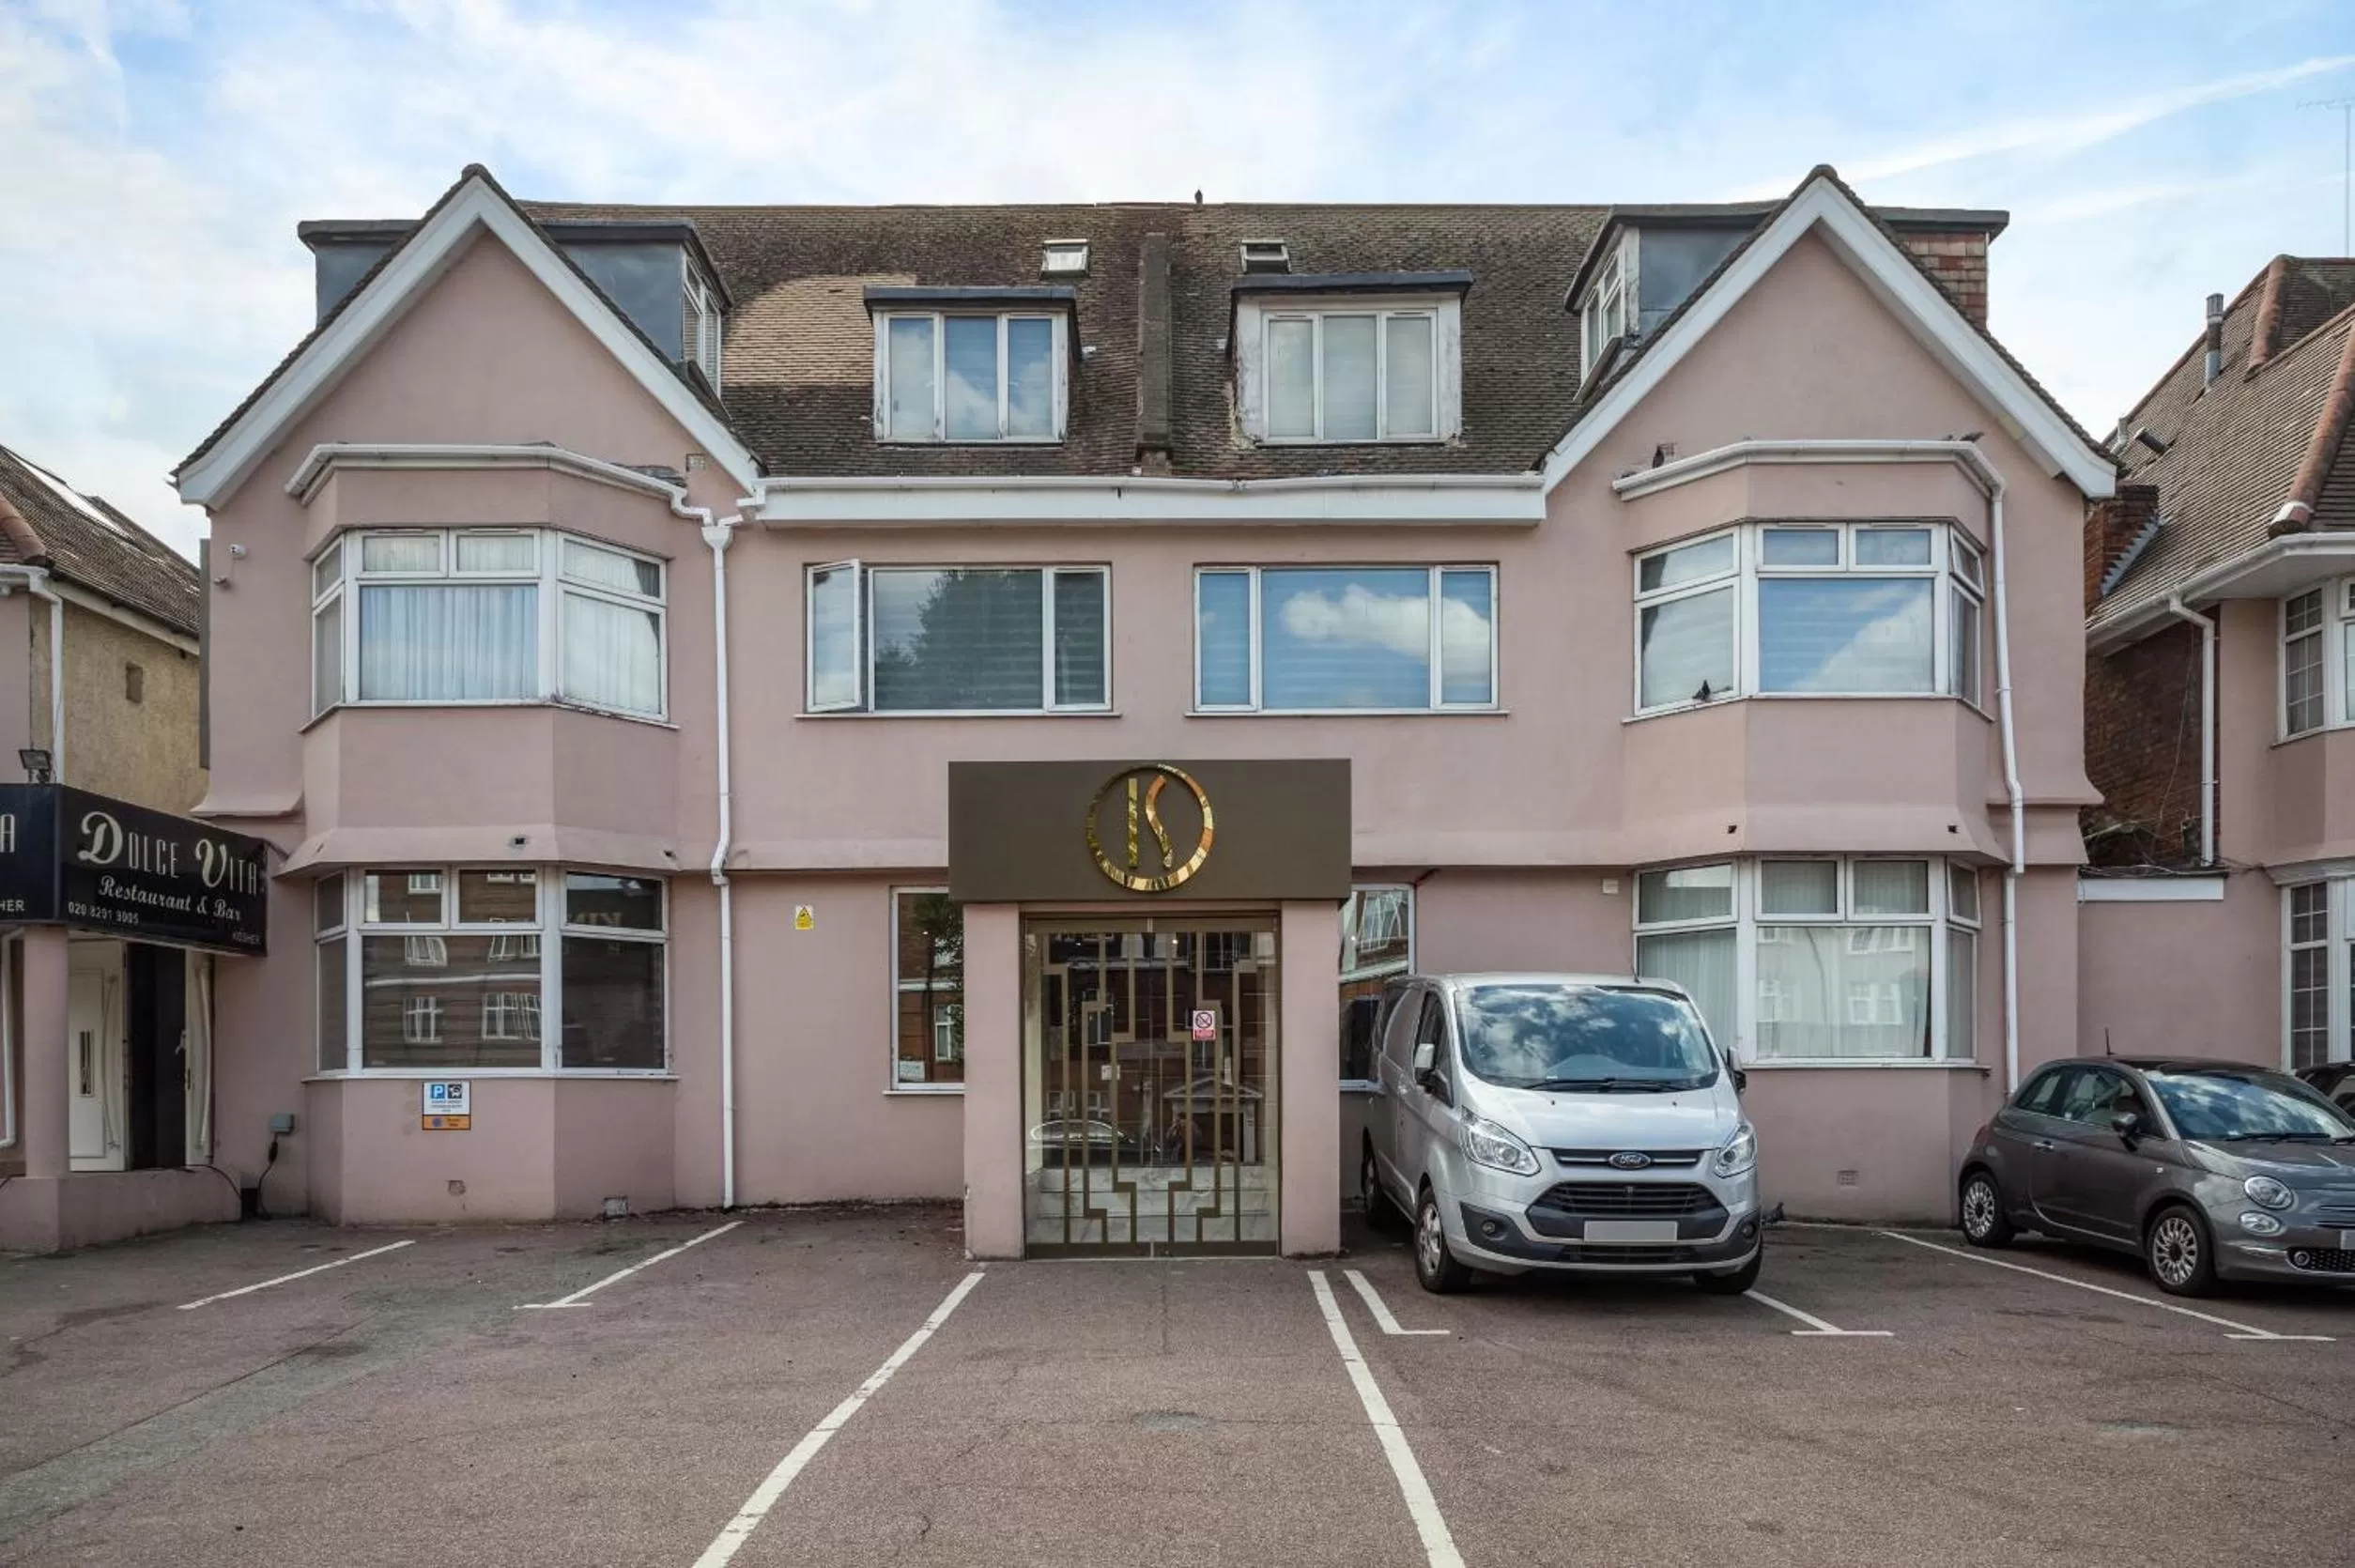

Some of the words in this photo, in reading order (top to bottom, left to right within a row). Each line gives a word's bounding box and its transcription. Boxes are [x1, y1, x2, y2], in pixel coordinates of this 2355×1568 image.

[77, 811, 180, 879] DOLCE
[195, 838, 258, 898] VITA
[98, 874, 192, 912] Restaurant
[196, 895, 208, 915] &
[212, 899, 241, 922] Bar
[434, 1085, 444, 1099] P
